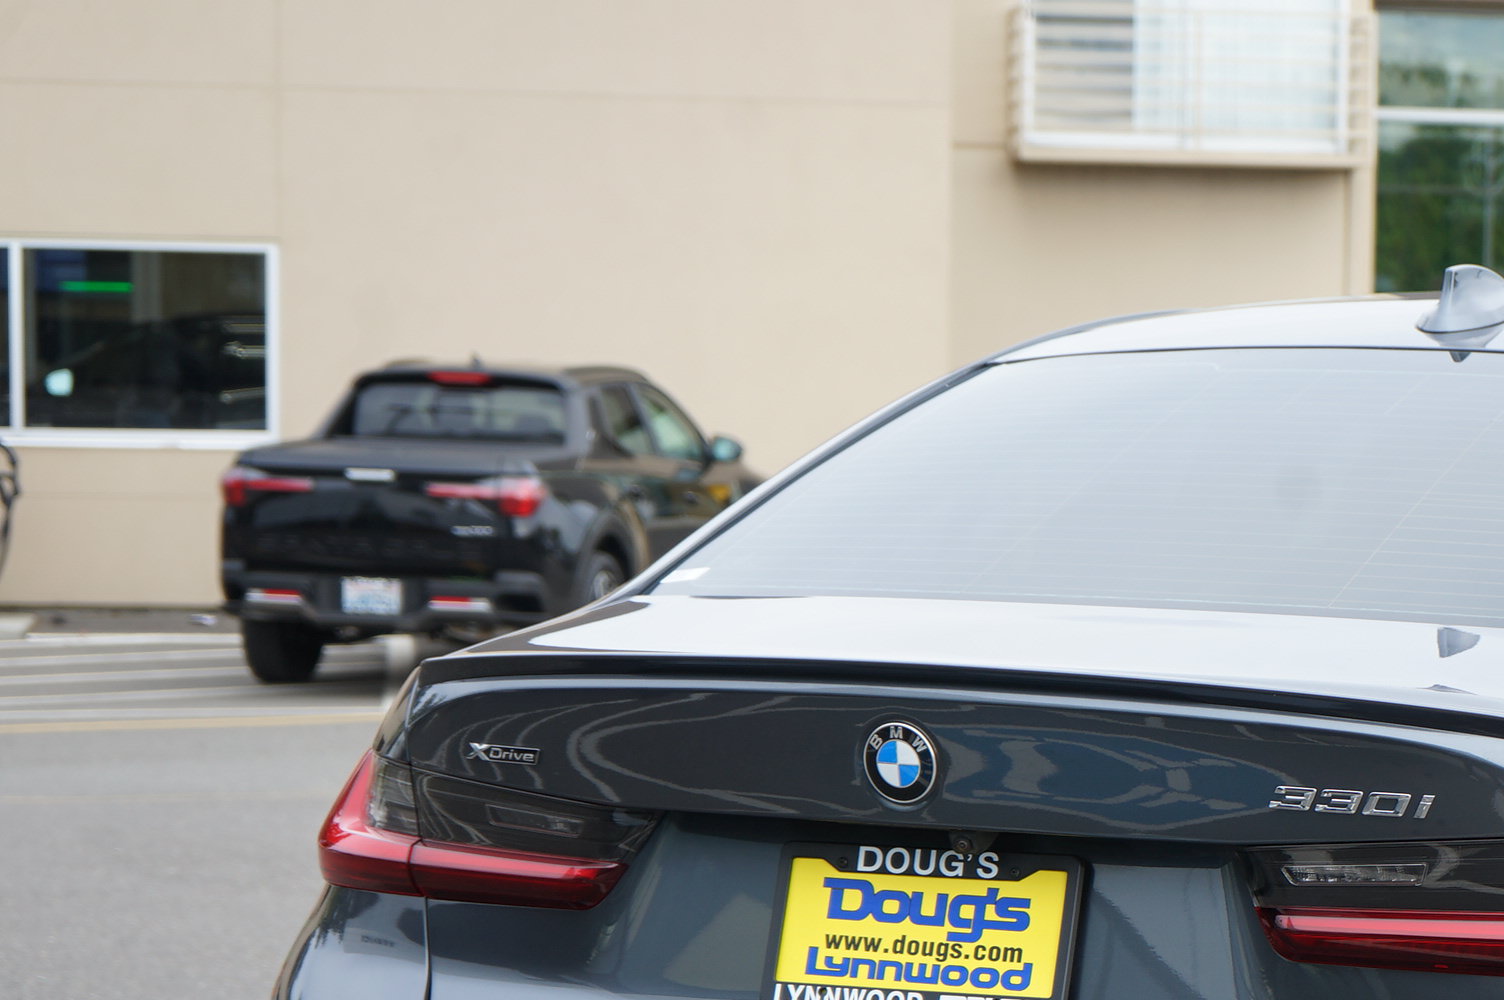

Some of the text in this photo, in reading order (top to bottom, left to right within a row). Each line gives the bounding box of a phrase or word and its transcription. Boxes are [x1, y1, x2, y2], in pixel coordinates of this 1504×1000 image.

[869, 726, 927, 753] BMW
[1268, 785, 1436, 819] 330i
[856, 845, 1000, 879] DOUG'S
[823, 876, 1032, 944] Doug's
[825, 932, 1024, 963] www.dougs.com
[804, 946, 1034, 992] Lynnwood
